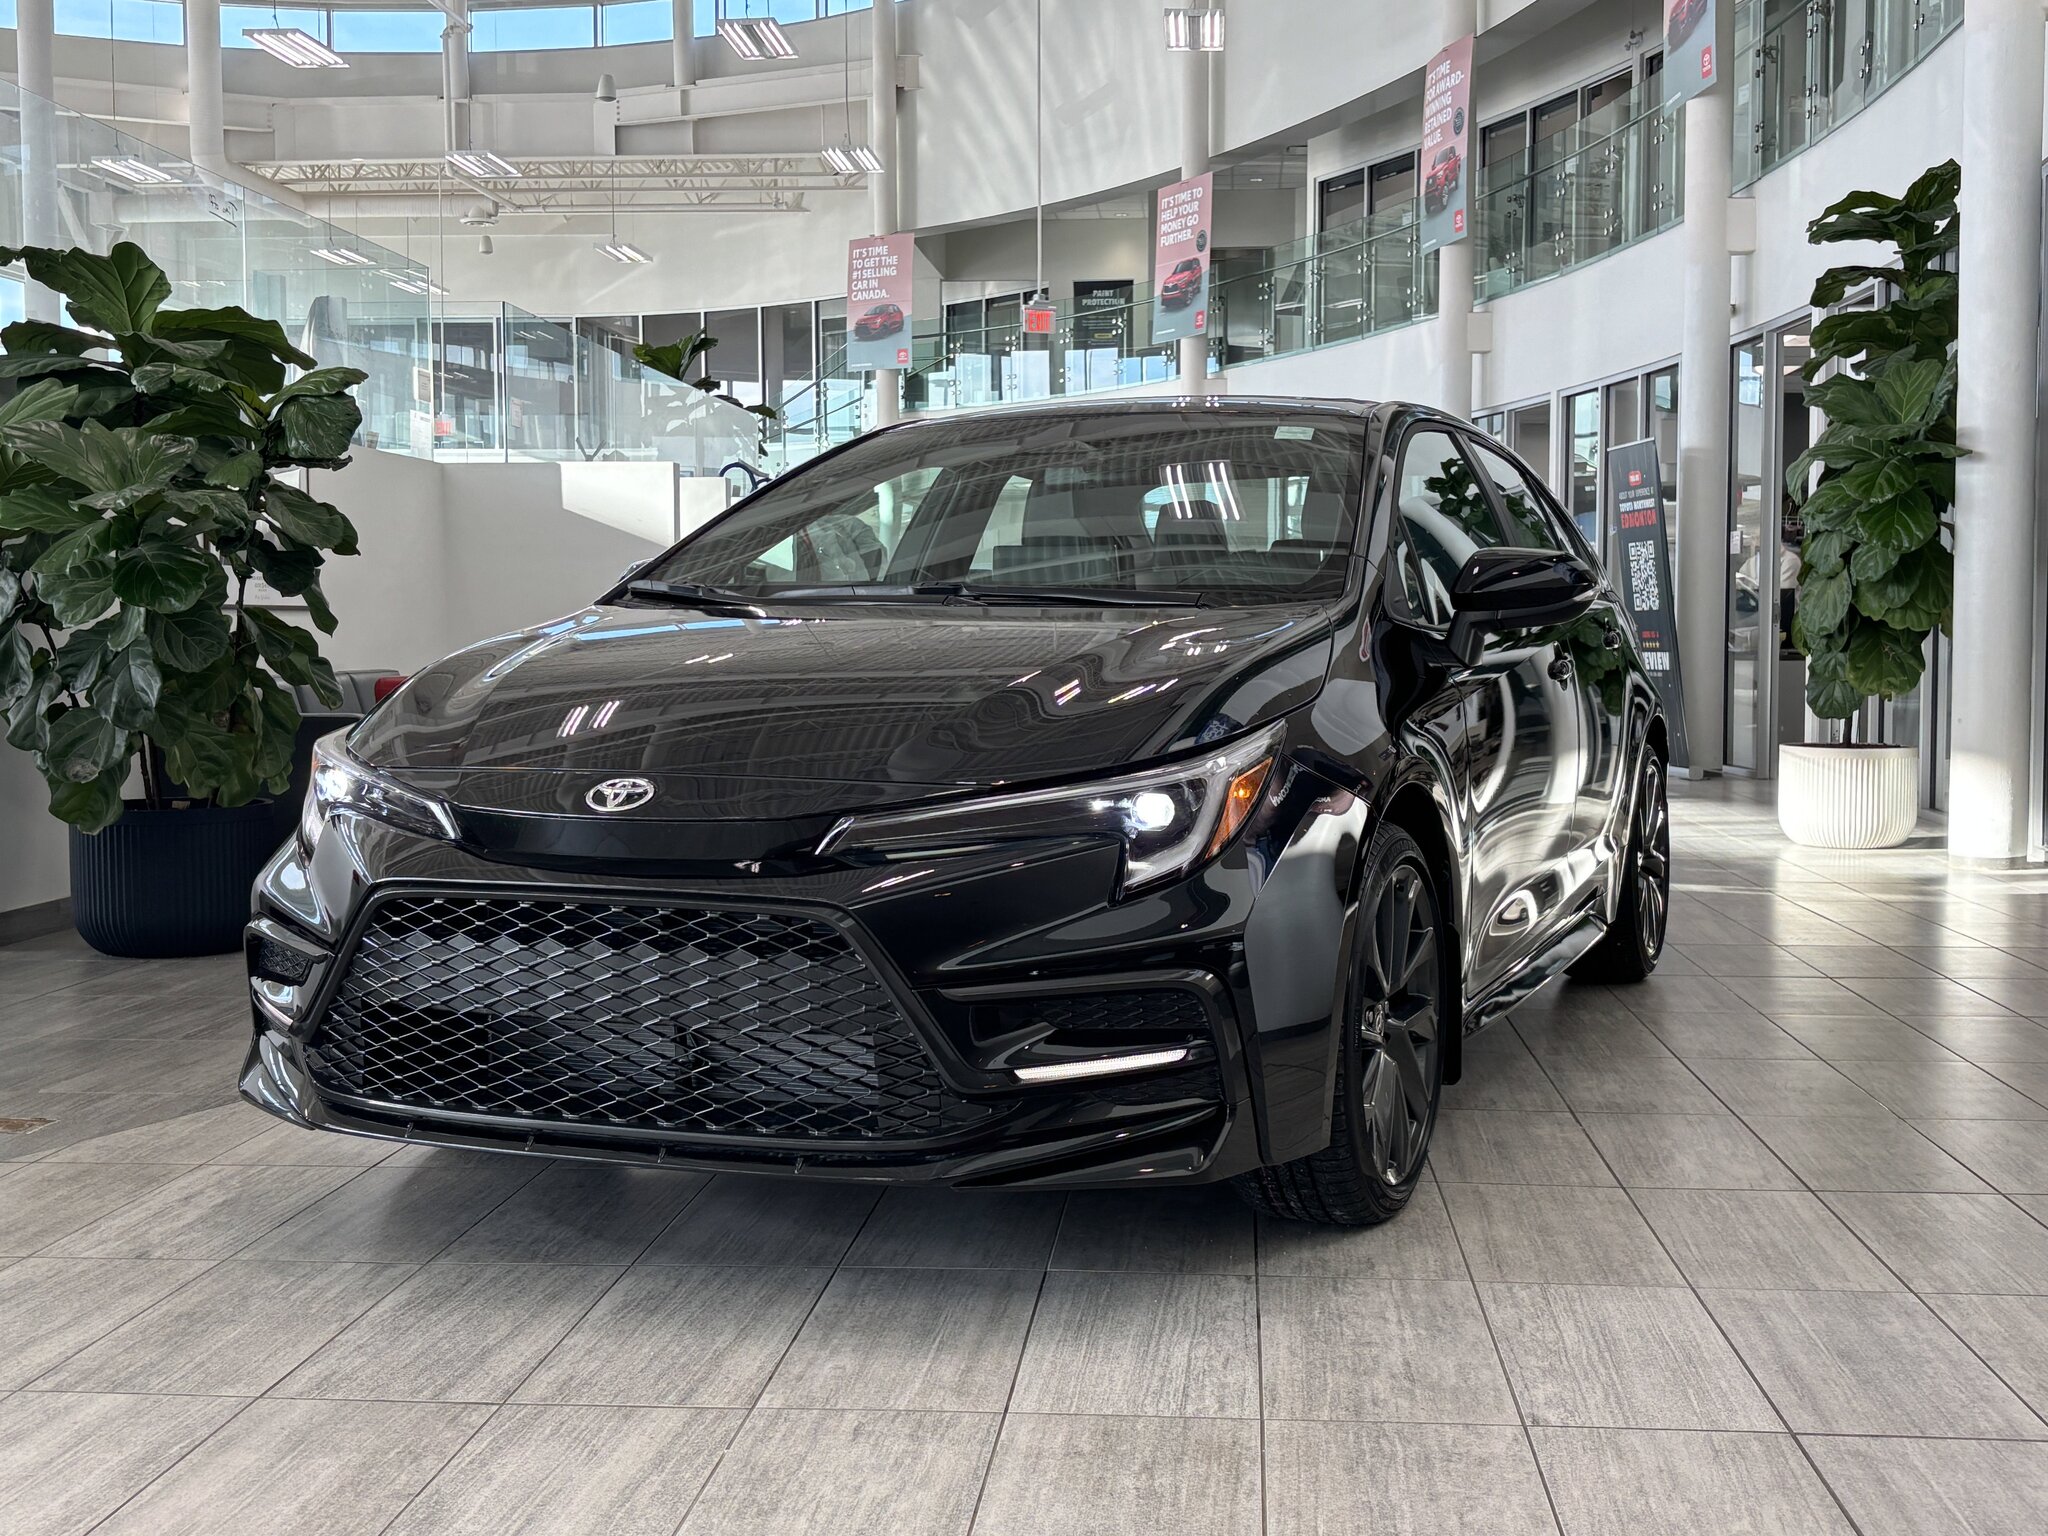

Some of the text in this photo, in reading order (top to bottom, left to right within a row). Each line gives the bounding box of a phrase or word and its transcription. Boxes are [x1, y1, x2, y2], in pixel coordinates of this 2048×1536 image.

[1435, 60, 1451, 80] TIME
[1426, 70, 1465, 104] FOR AWARD-
[1425, 91, 1452, 118] WINNING
[1424, 107, 1453, 134] RETAINED
[1423, 128, 1443, 150] VALUE.
[1161, 187, 1203, 210] IT'S TIME TO
[1161, 201, 1199, 222] HELP YOUR
[1160, 213, 1199, 235] MONEY GO
[1160, 228, 1195, 248] FURTHER.
[852, 245, 889, 259] IT'S TIME
[852, 255, 899, 270] TO GET THE
[852, 266, 898, 280] #1 SELLING
[851, 278, 879, 291] CAR IN
[1092, 289, 1115, 298] PAINT
[851, 288, 890, 302] CANADA.
[1082, 297, 1126, 307] PROTECTION
[1028, 310, 1051, 332] EXIT
[1620, 508, 1657, 529] EDMONTON
[1641, 651, 1670, 671] EVIEW
